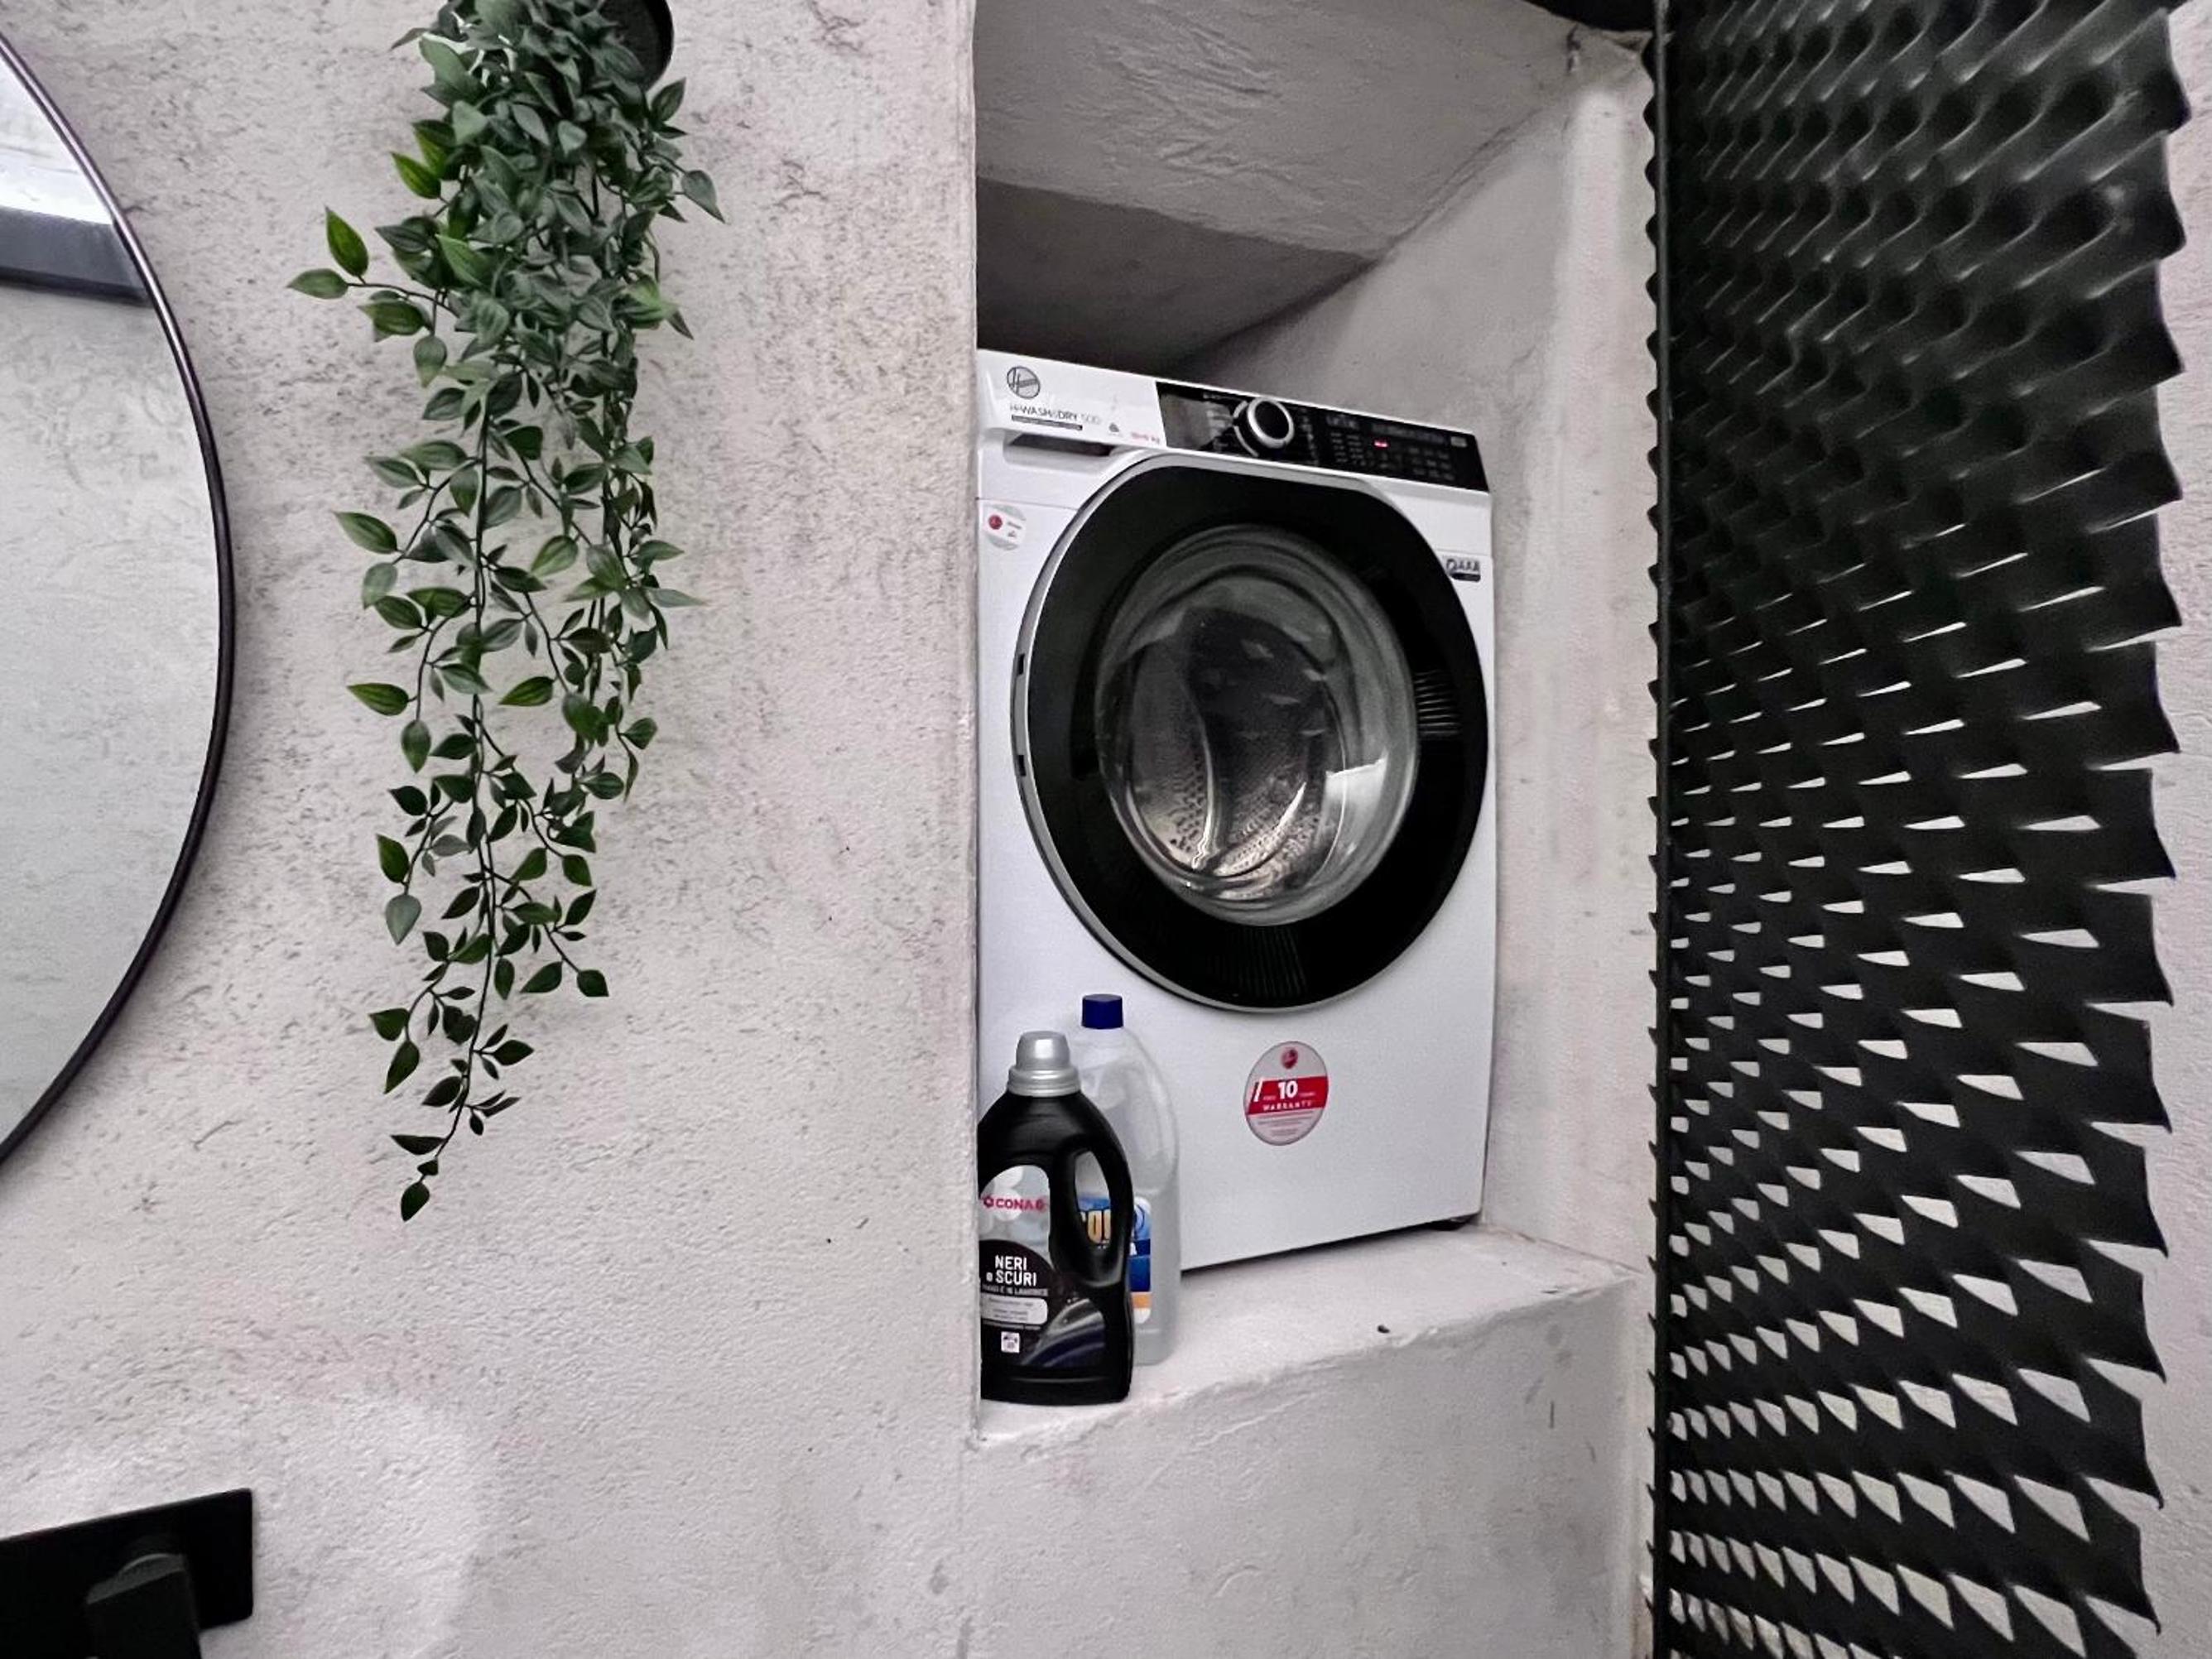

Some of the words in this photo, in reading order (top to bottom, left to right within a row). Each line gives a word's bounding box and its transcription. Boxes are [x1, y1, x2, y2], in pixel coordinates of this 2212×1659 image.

[1277, 1080, 1298, 1099] 10
[994, 1254, 1027, 1271] NERI
[996, 1269, 1037, 1287] SCURI
